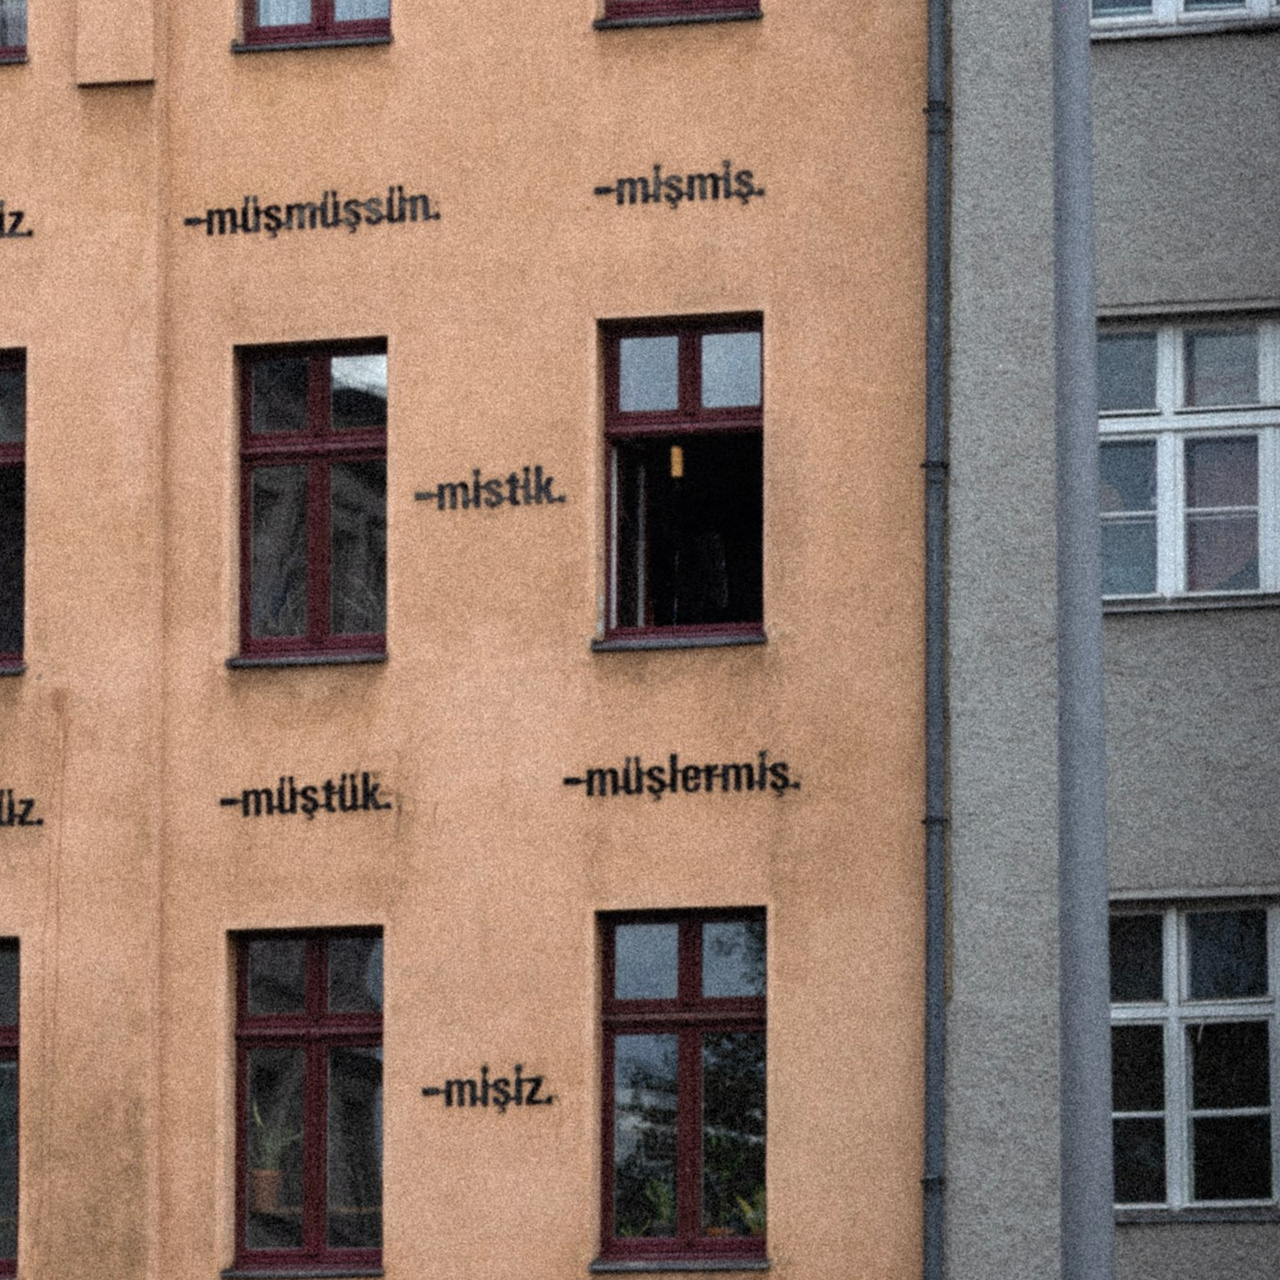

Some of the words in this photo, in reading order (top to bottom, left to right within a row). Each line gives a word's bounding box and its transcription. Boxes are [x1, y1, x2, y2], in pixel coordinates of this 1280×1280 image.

[593, 159, 766, 210] -mişmiş.
[183, 184, 441, 239] -müşmüşsün.
[219, 771, 392, 821] -müştük.
[563, 750, 801, 803] -müşlermiş.
[421, 1062, 557, 1114] -mişiz.
